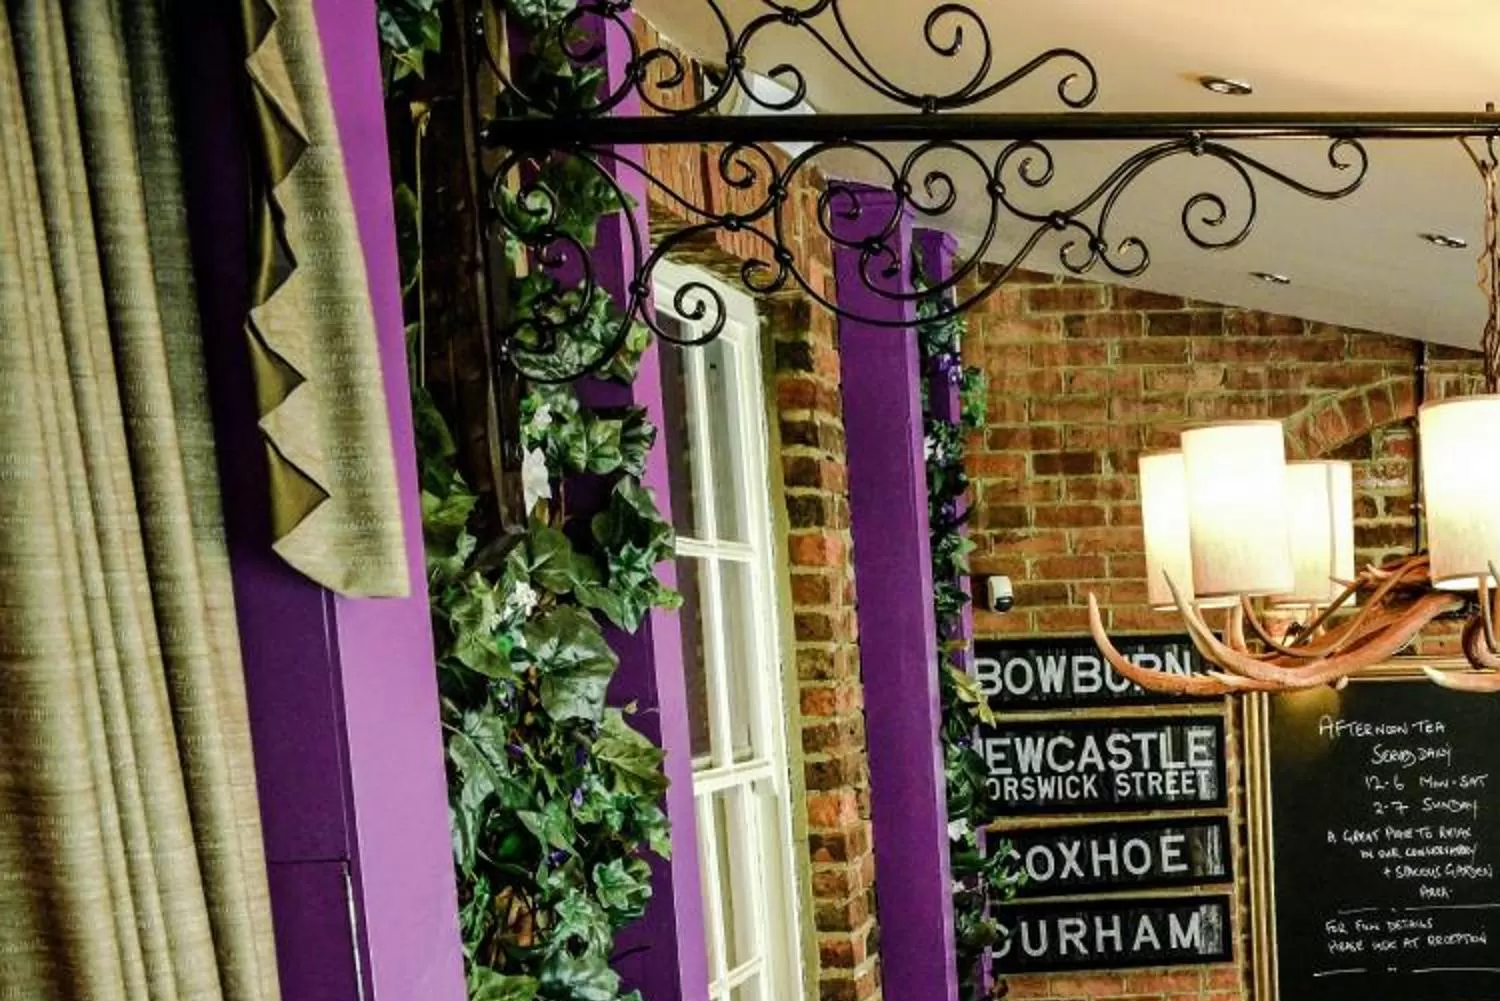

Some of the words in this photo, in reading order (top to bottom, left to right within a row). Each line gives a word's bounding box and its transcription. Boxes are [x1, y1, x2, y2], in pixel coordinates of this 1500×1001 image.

[1319, 715, 1408, 739] AFTERNOON
[1412, 720, 1445, 734] TEA
[1116, 770, 1211, 798] STREET
[1422, 797, 1477, 820] SUNDAY
